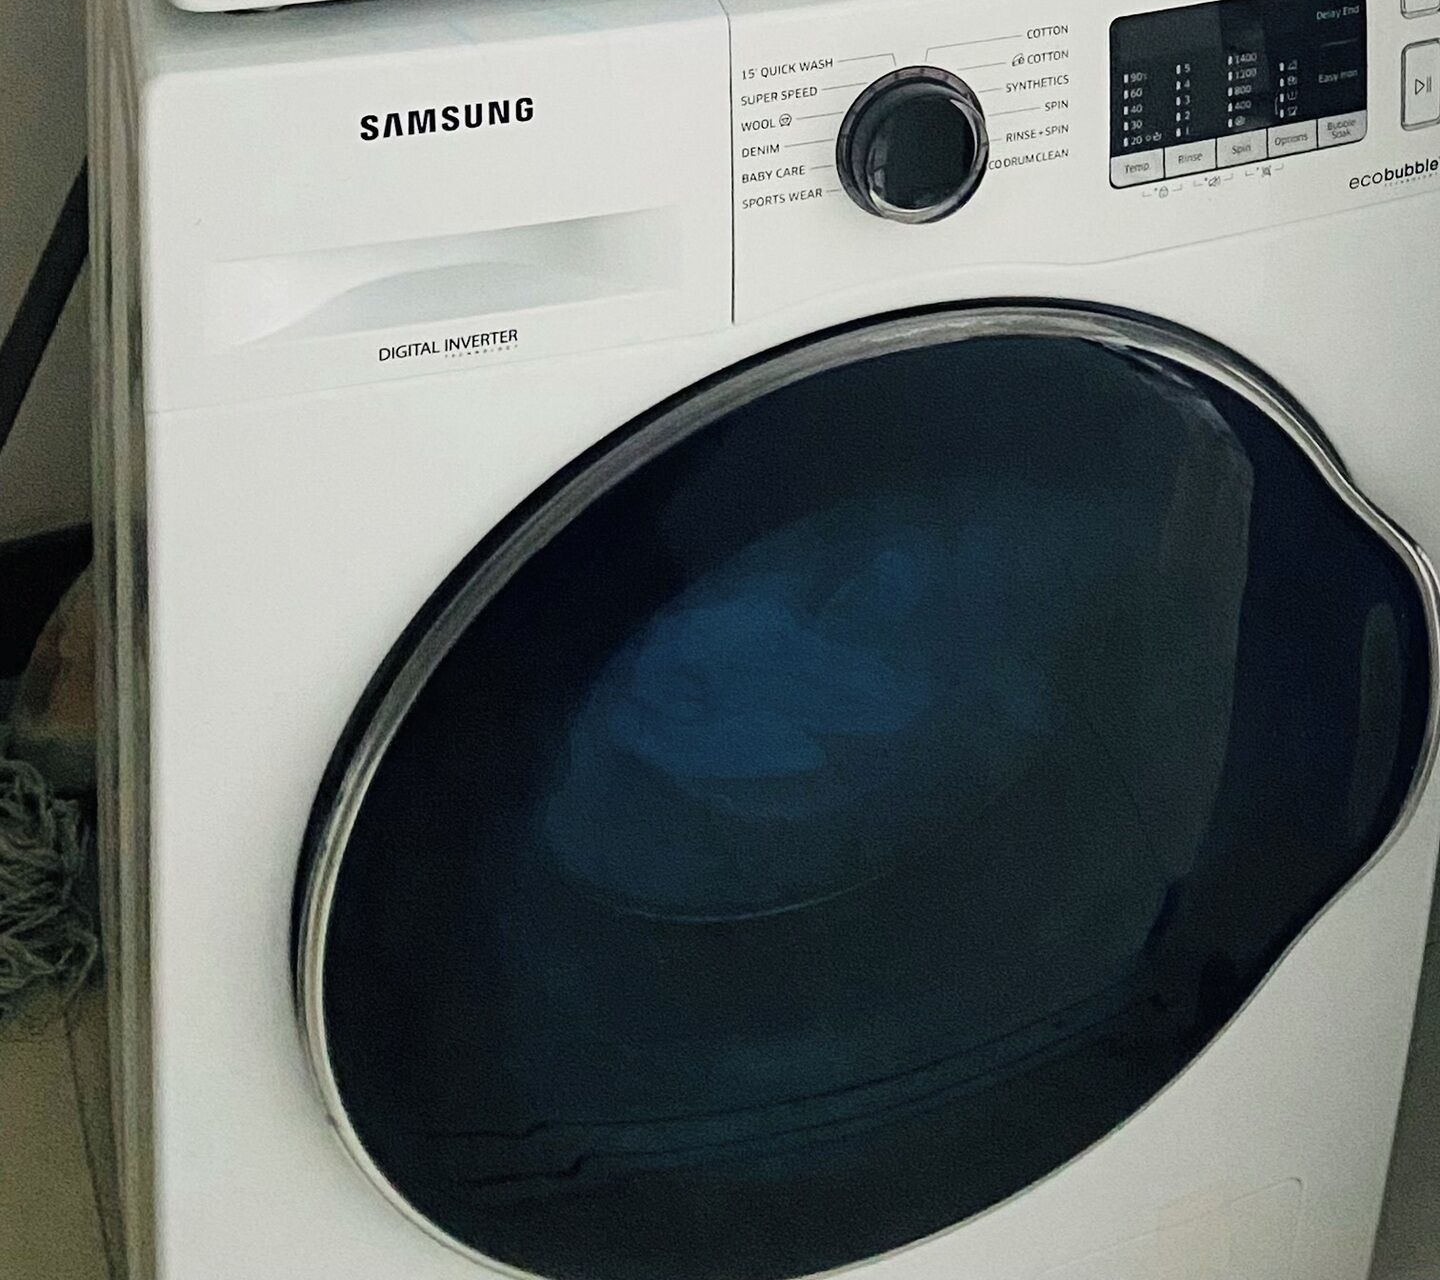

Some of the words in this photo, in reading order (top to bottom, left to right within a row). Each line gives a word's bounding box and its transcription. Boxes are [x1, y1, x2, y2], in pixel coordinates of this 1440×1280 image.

[1026, 24, 1069, 40] COTTON
[1027, 49, 1069, 65] COTTON
[760, 62, 796, 80] QUICK
[799, 57, 834, 74] WASH
[1005, 74, 1070, 93] SYNTHETICS
[1184, 79, 1191, 88] 4
[741, 91, 778, 107] SUPER
[781, 85, 818, 102] SPEED
[1130, 88, 1143, 98] 60
[1184, 95, 1191, 104] 3
[1044, 99, 1069, 112] SPIN
[1130, 104, 1143, 114] 40
[360, 97, 534, 141] SAMSUNG
[1184, 111, 1191, 120] 2
[741, 118, 776, 133] WOOL
[1130, 120, 1143, 130] 30
[1130, 135, 1143, 146] 20
[741, 143, 780, 159] DENIM
[988, 159, 1002, 171] CO
[1035, 148, 1069, 163] CLEAN
[741, 168, 773, 184] BABY
[776, 165, 806, 180] CARE
[742, 193, 786, 209] SPORTS
[789, 188, 822, 203] WEAR
[379, 341, 440, 361] DIGITAL
[445, 329, 518, 352] INVERTER
